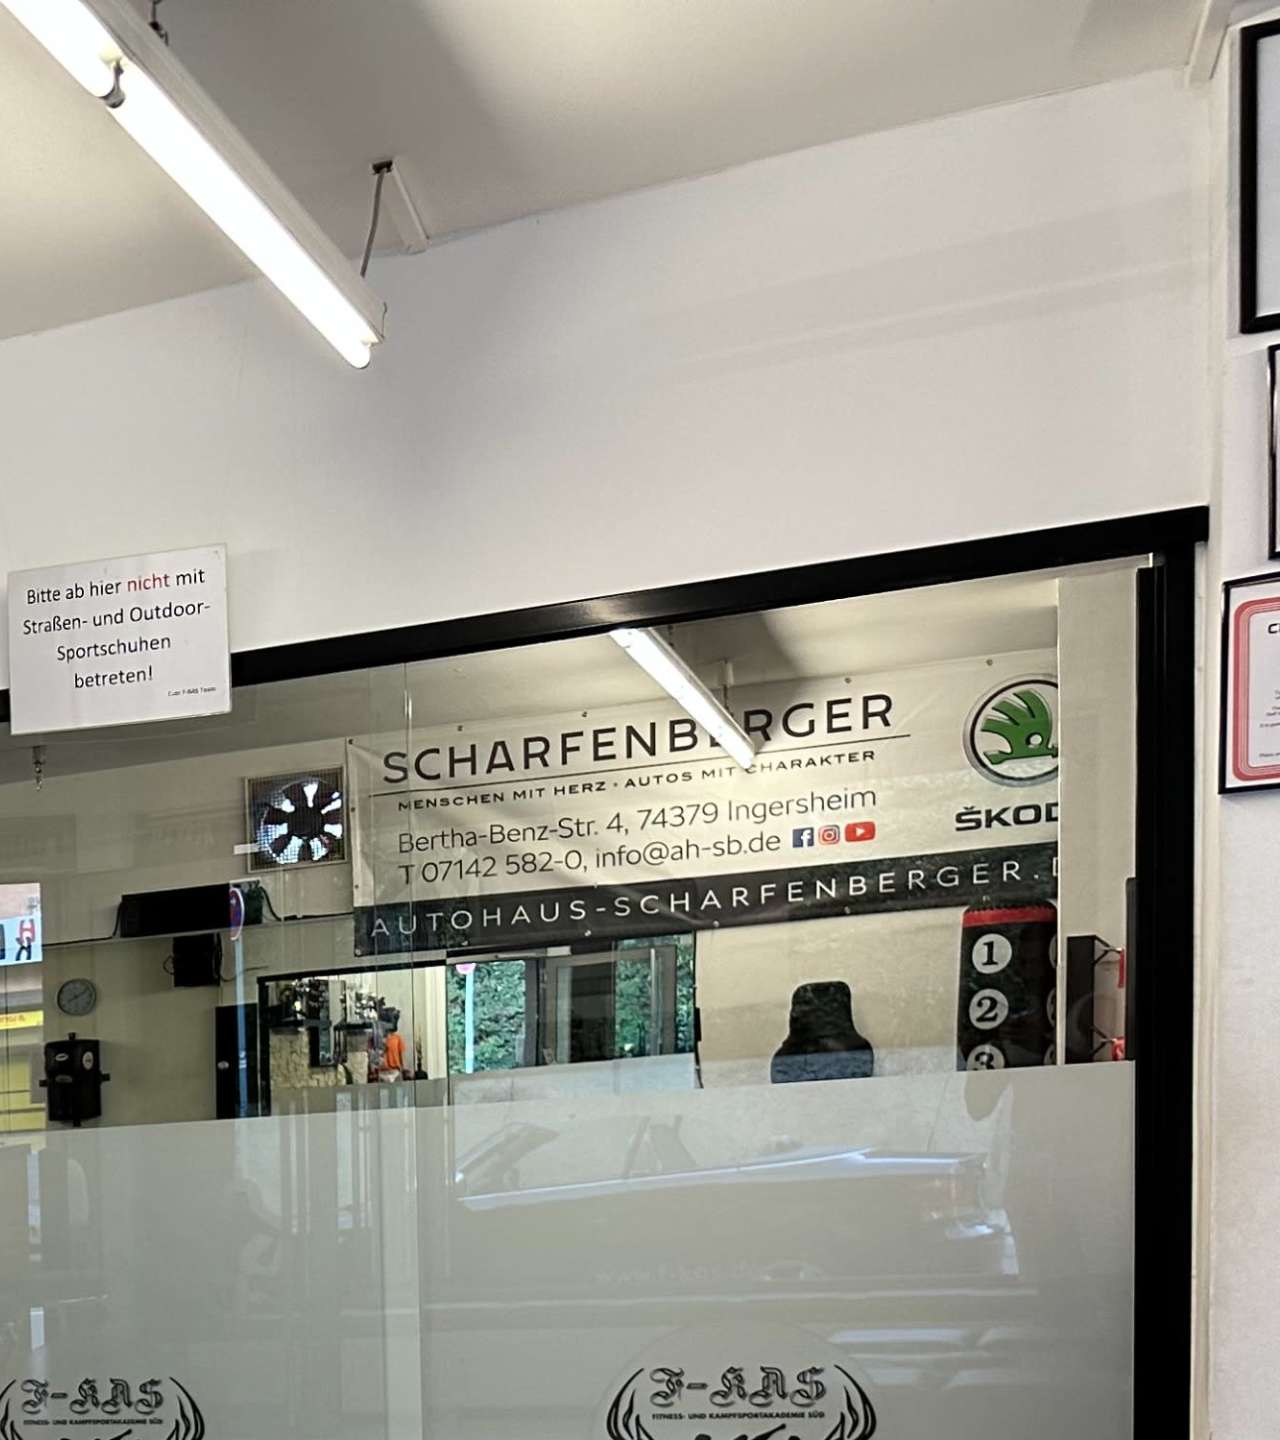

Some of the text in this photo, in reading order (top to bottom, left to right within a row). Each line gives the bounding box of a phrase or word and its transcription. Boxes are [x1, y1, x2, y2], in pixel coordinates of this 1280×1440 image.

[27, 568, 206, 604] Bitte ab hier nicht mit
[23, 601, 211, 635] Straßen- und Outdoor-
[56, 635, 172, 664] Sportschuhen
[74, 665, 154, 689] betreten!
[383, 693, 894, 784] SCHARFENBRGER
[398, 750, 876, 811] MENSCHEN MIT HERZ AUTOS MIT CHARAKTER
[399, 788, 877, 854] Bertha-Benz-Str. 4, 74379 Ingersheim
[398, 831, 781, 885] T 07142 582-0, info@ah-sb.de
[370, 857, 1058, 938] AUTOHAUS-SCHARFENBERGER.
[982, 941, 998, 966] 1
[977, 998, 999, 1022] 2
